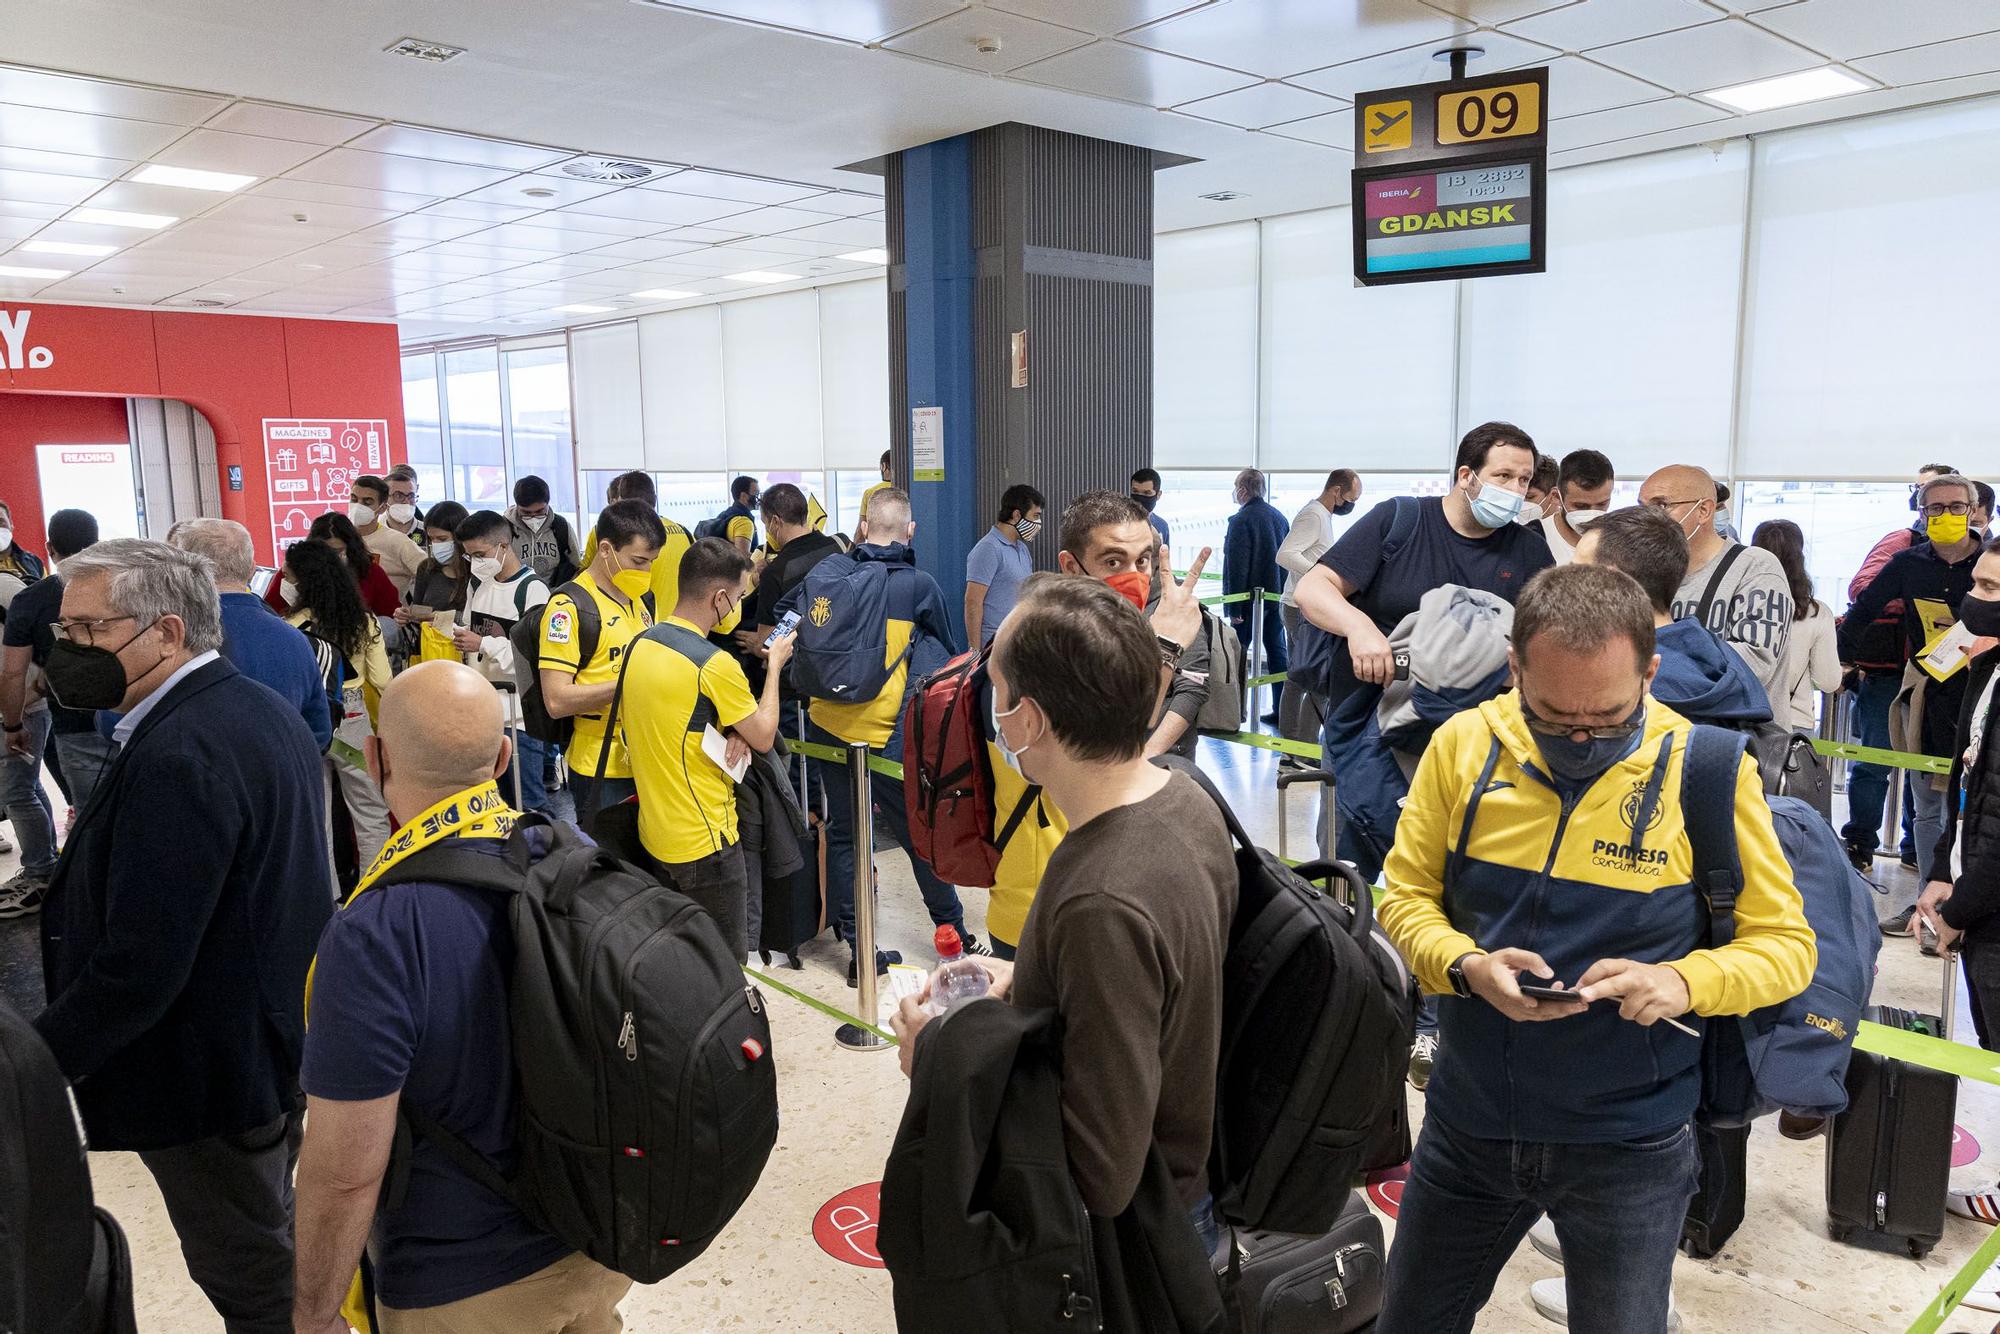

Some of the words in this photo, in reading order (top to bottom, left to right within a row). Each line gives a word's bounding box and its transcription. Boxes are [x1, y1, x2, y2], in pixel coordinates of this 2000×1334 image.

[1457, 91, 1519, 138] 09
[1379, 188, 1410, 199] IBERIA
[1379, 203, 1516, 234] GDANSK
[274, 429, 329, 438] MAGAZINES
[62, 453, 113, 463] READING
[369, 434, 378, 465] TRAVEL
[279, 481, 305, 490] GIFTS
[521, 542, 557, 559] RAMS
[421, 802, 461, 838] DE
[1592, 839, 1669, 865] PAMESA
